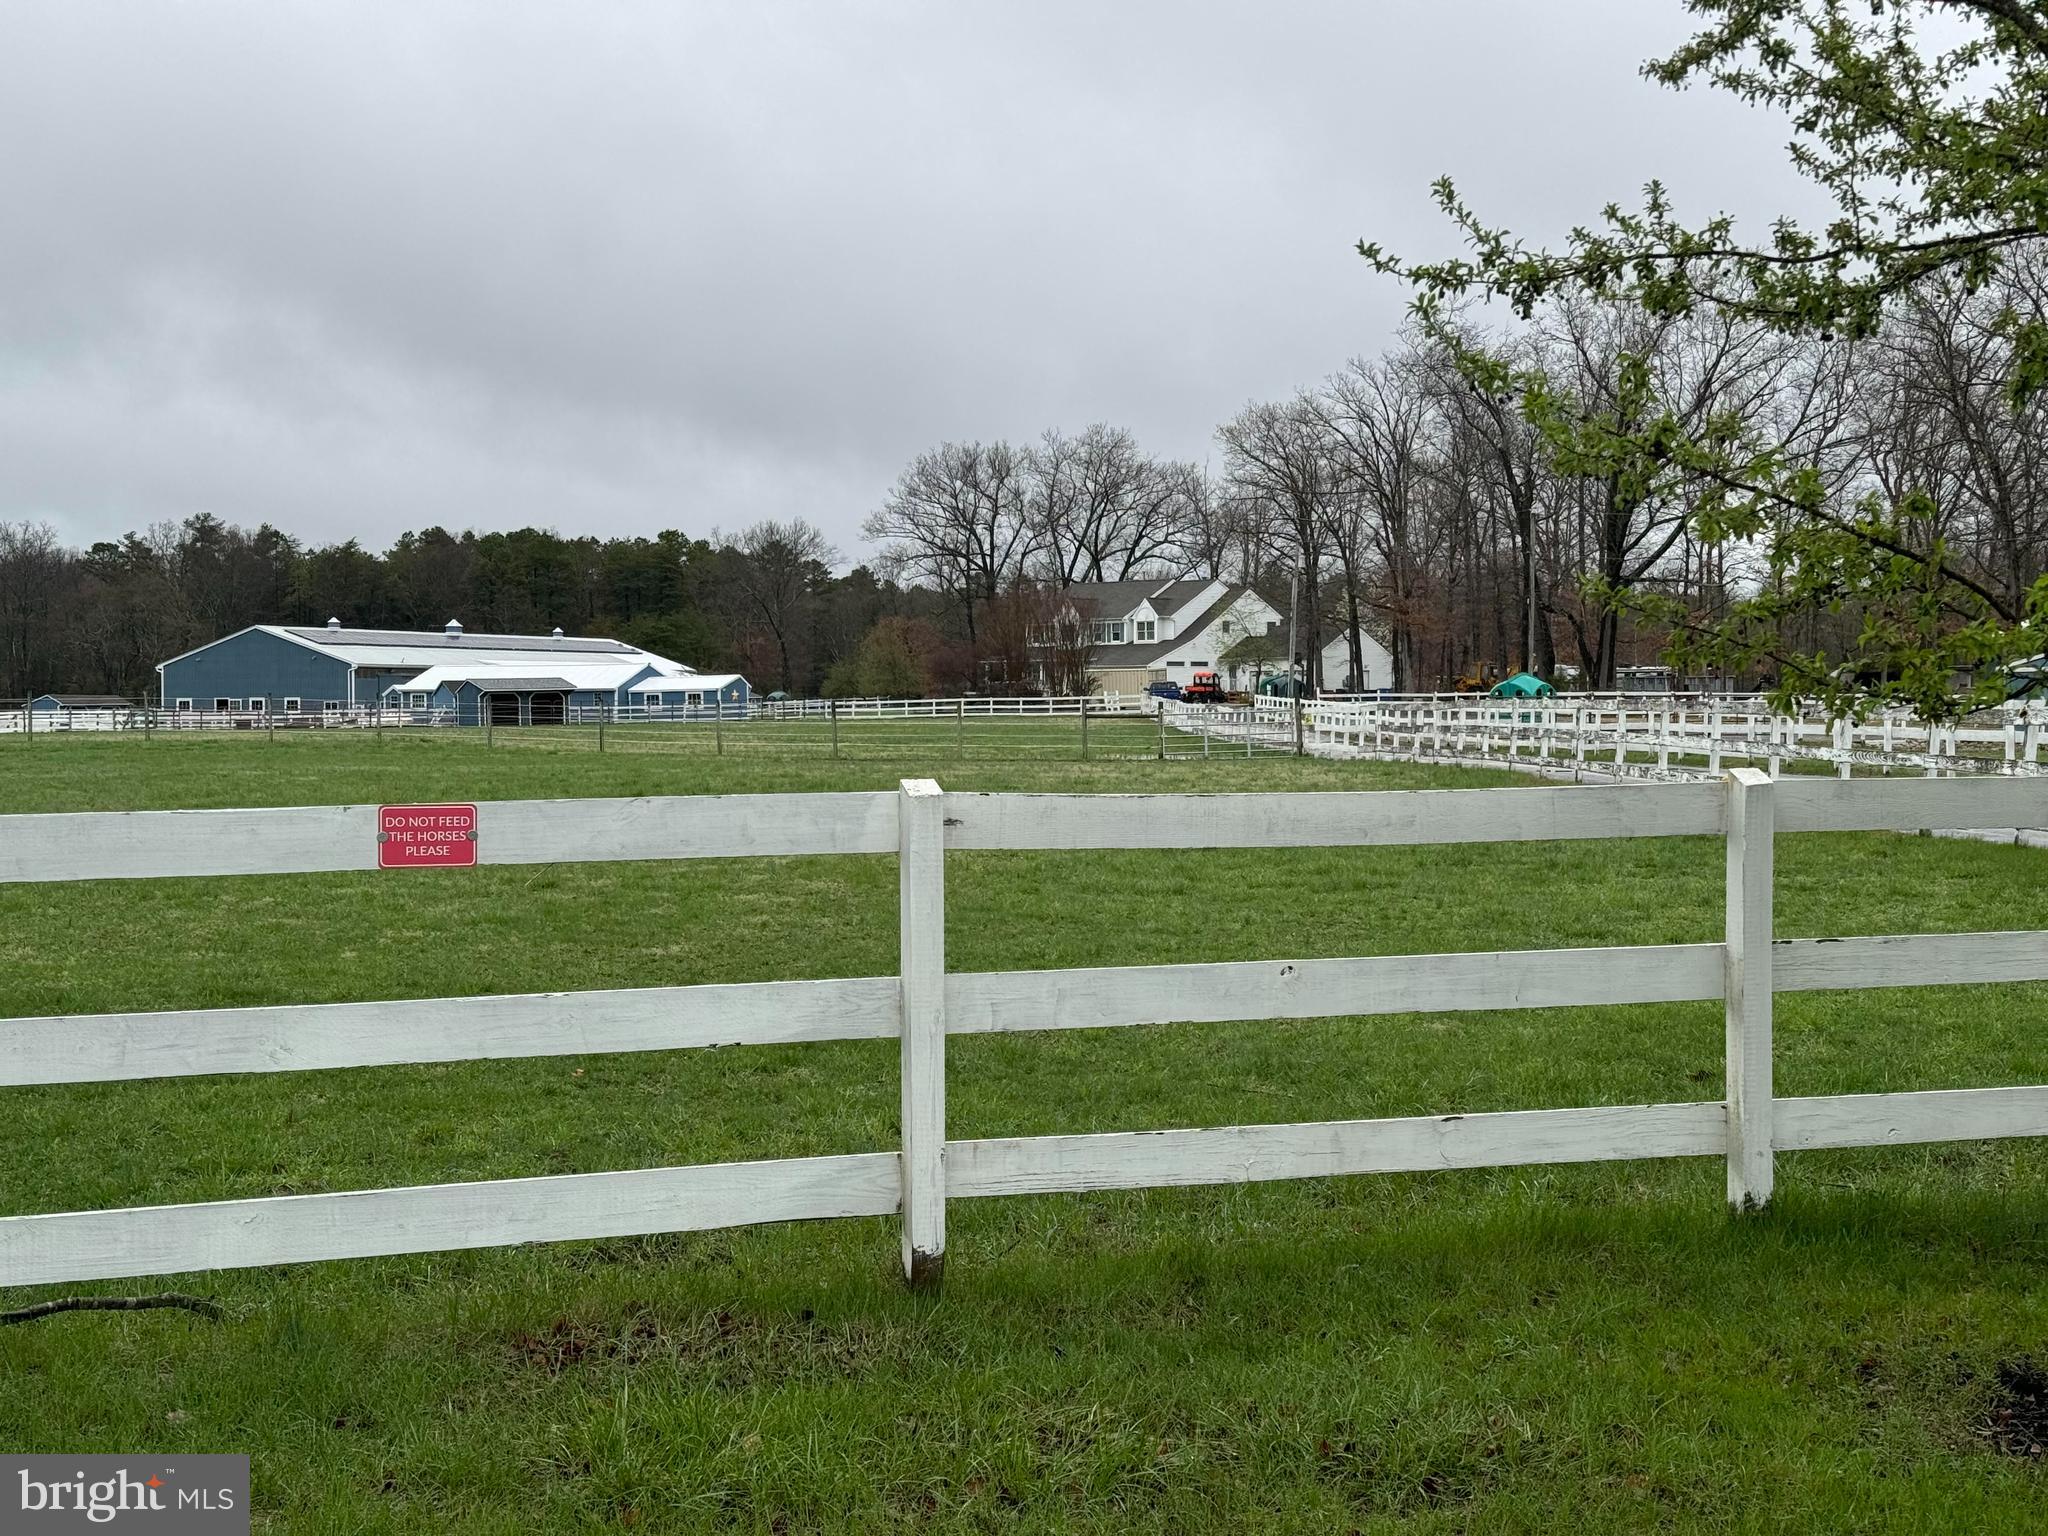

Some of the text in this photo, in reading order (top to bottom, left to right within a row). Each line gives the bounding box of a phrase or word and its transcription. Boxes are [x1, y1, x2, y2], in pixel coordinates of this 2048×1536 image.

[385, 816, 470, 828] DO NOT FEED
[388, 830, 467, 842] THE HORSES
[405, 845, 451, 857] PLEASE
